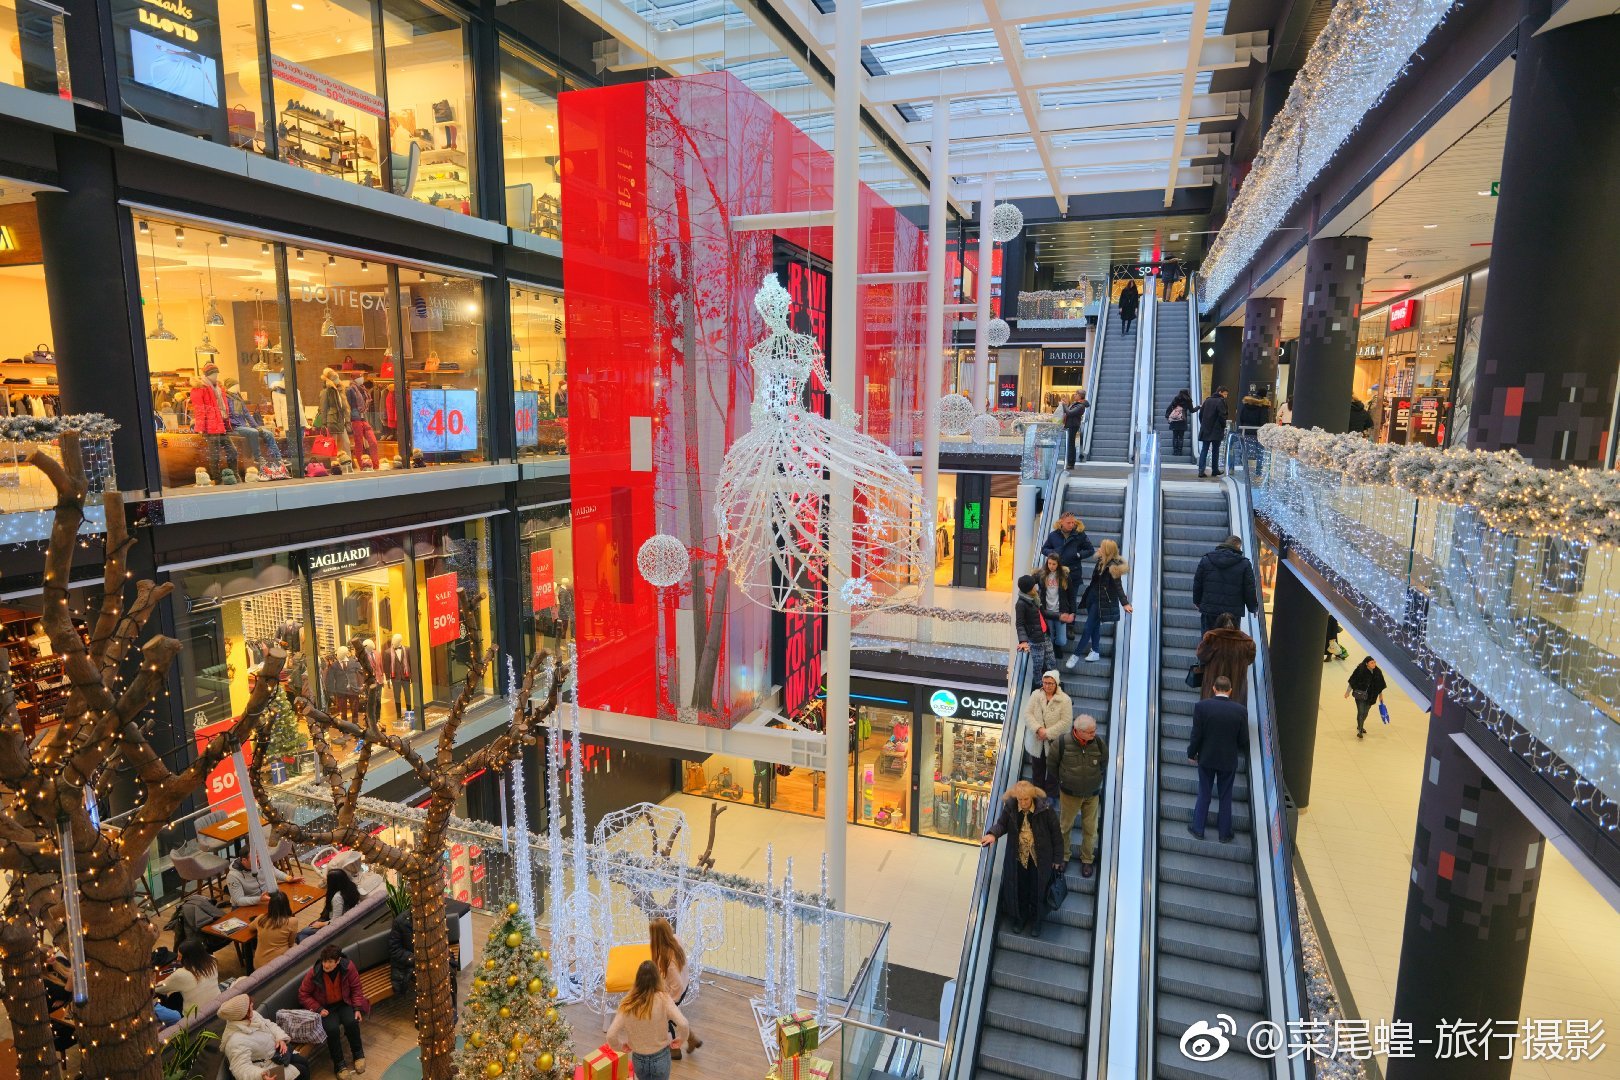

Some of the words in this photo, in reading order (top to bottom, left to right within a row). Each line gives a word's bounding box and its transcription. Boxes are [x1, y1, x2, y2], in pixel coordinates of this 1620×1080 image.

[138, 8, 199, 42] LLOYD
[434, 590, 452, 601] SALE
[433, 611, 456, 630] 50%
[971, 709, 1006, 720] SPORTS
